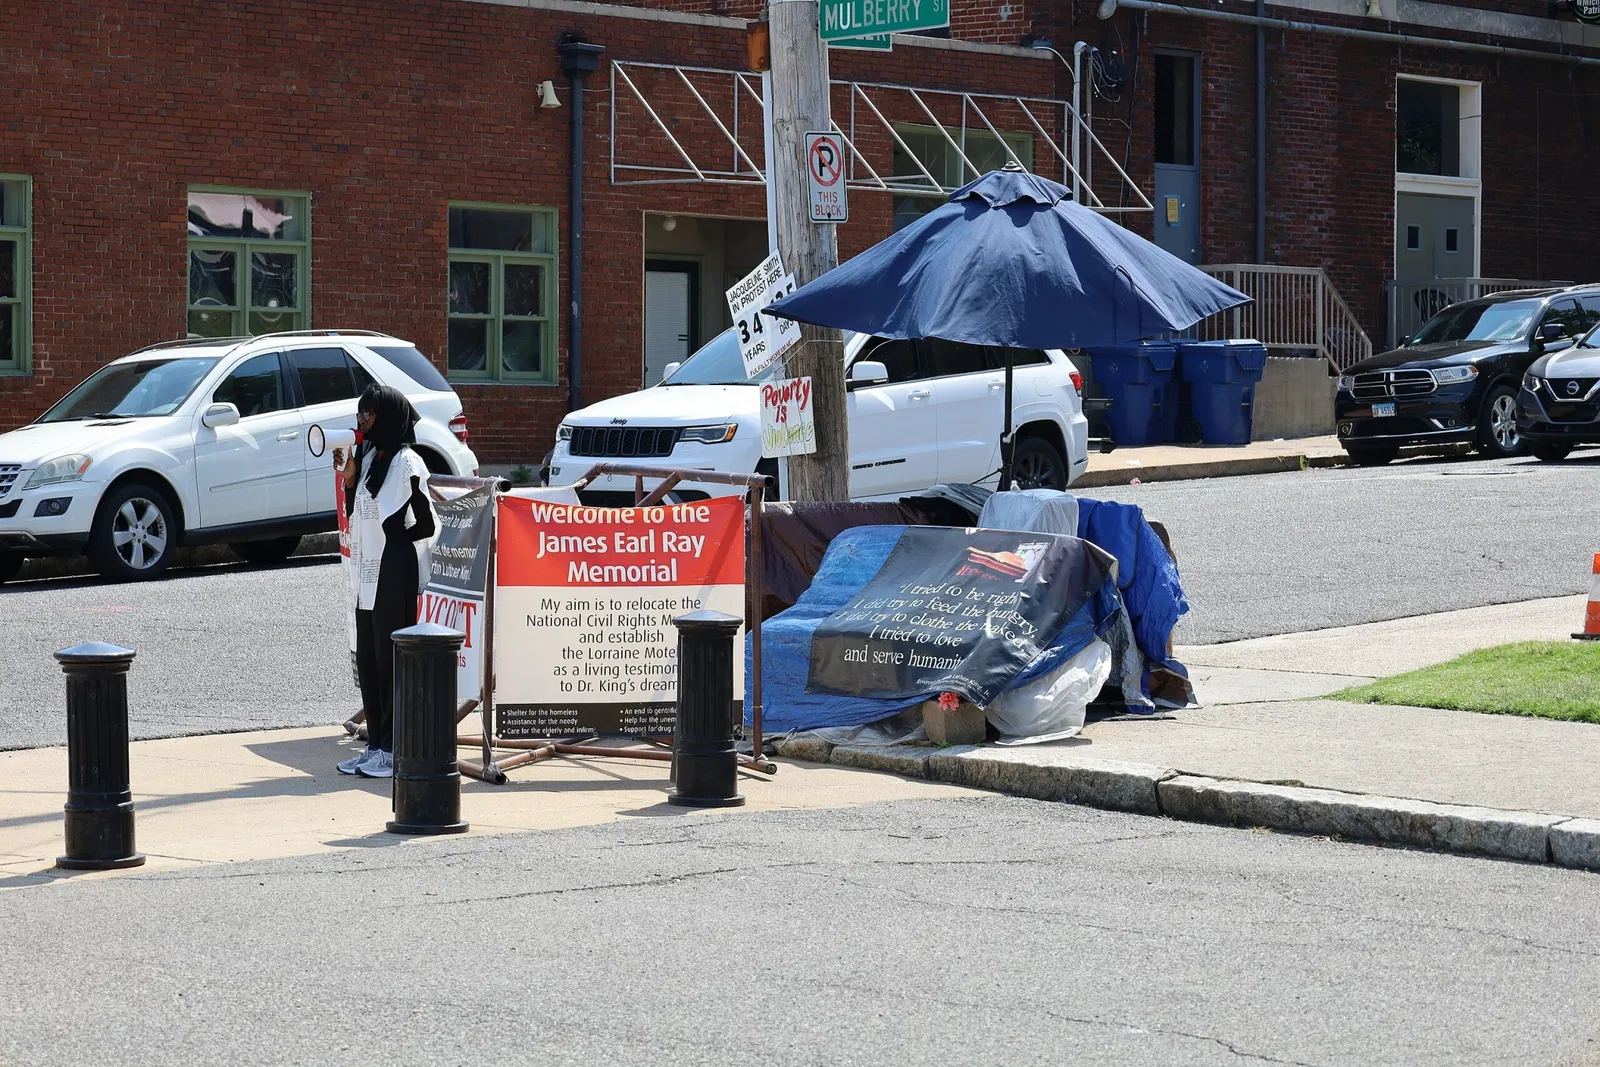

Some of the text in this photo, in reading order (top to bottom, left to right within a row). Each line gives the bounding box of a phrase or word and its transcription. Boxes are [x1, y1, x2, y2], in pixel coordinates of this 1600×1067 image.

[825, 0, 921, 31] MULBERRY
[818, 191, 838, 203] THIS
[815, 204, 842, 216] BLOCK
[729, 269, 763, 303] JACQUELINE
[763, 255, 780, 275] SMITH
[732, 302, 740, 314] IN
[741, 280, 767, 308] PROTEST
[767, 266, 783, 287] HERE
[744, 340, 766, 362] YEARS
[762, 378, 811, 411] Poverty
[609, 417, 628, 426] Jeep
[531, 502, 710, 524] Welcome to the
[536, 529, 706, 559] James Earl Ray
[567, 558, 678, 583] Memorial
[910, 582, 947, 595] tried
[945, 584, 963, 597] to
[965, 587, 985, 600] be
[986, 591, 1017, 607] righ
[541, 596, 701, 614] My aim is to relocate the
[853, 599, 865, 609] I
[863, 597, 890, 609] did
[886, 597, 909, 610] try
[908, 598, 924, 608] to
[925, 597, 963, 614] feed
[961, 604, 985, 617] the
[526, 613, 582, 627] National
[586, 613, 613, 627] Civil
[617, 613, 657, 630] Rights
[835, 611, 848, 620] I
[845, 610, 873, 621] did
[868, 611, 892, 624] try
[891, 611, 907, 622] to
[909, 612, 953, 630] clothe
[955, 620, 979, 631] the
[579, 629, 664, 644] and establish
[869, 624, 963, 647] I tried to love
[562, 646, 677, 660] the Lorraine Mote
[844, 644, 966, 671] and serve humanit
[553, 662, 678, 679] as a living testimon
[560, 680, 573, 692] to
[577, 679, 594, 692] Dr.
[599, 678, 636, 695] King's
[538, 708, 548, 716] the
[549, 708, 578, 716] homeless
[624, 716, 638, 724] Help
[547, 717, 558, 725] the
[559, 718, 578, 726] needy
[624, 725, 647, 733] Support
[657, 725, 671, 733] drug
[521, 727, 531, 735] for
